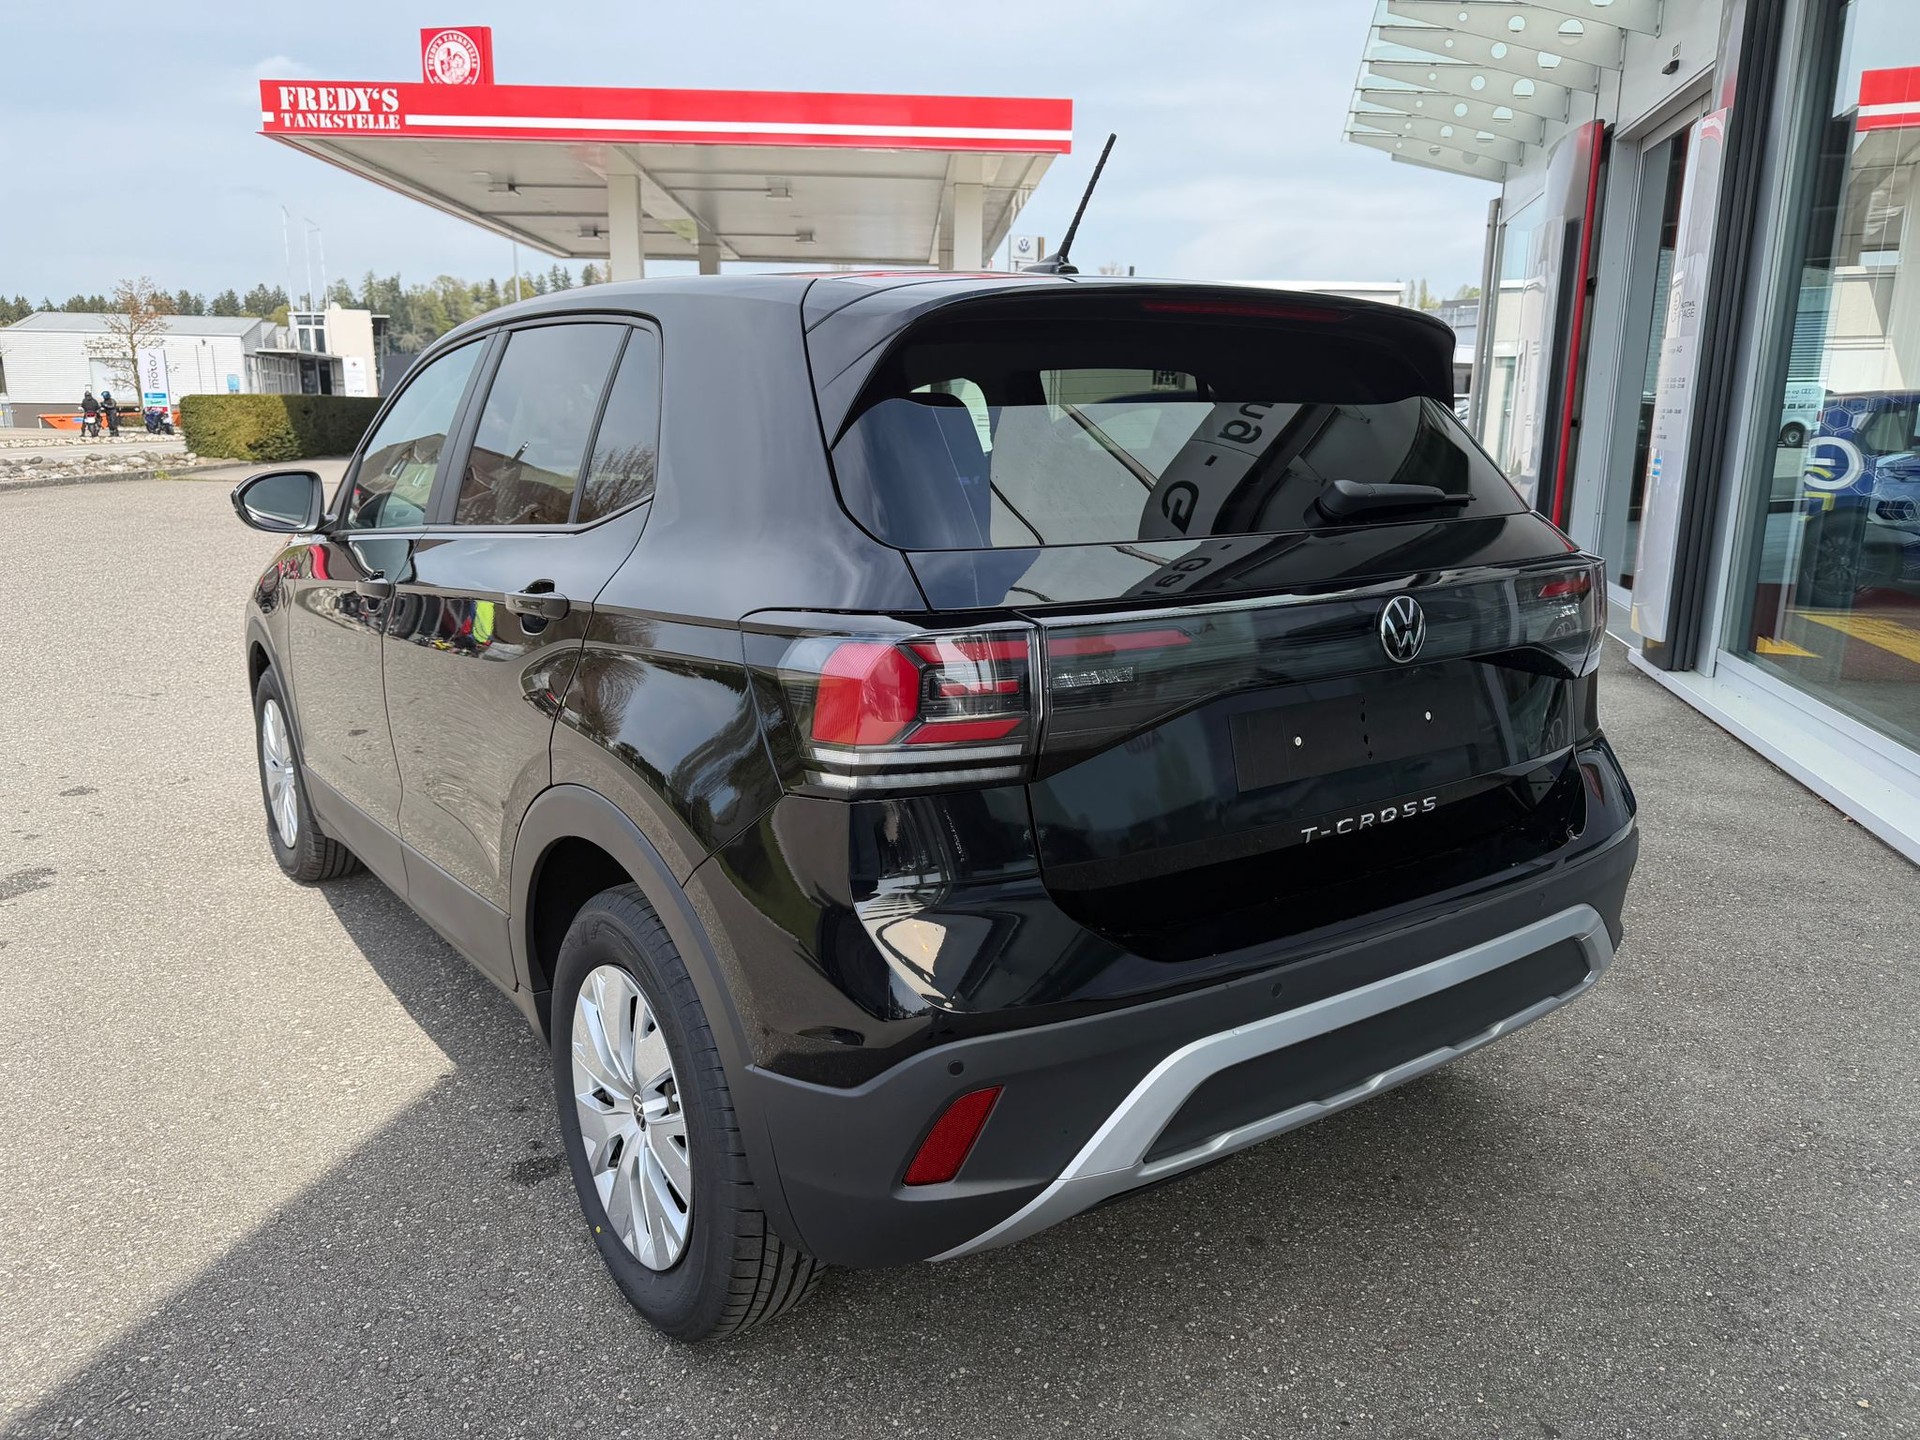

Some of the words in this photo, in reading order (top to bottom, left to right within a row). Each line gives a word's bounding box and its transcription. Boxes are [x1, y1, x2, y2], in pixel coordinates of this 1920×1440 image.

[281, 113, 400, 129] TANKSTELLE
[1381, 596, 1425, 663] VW
[1301, 796, 1437, 844] T-CROSS
